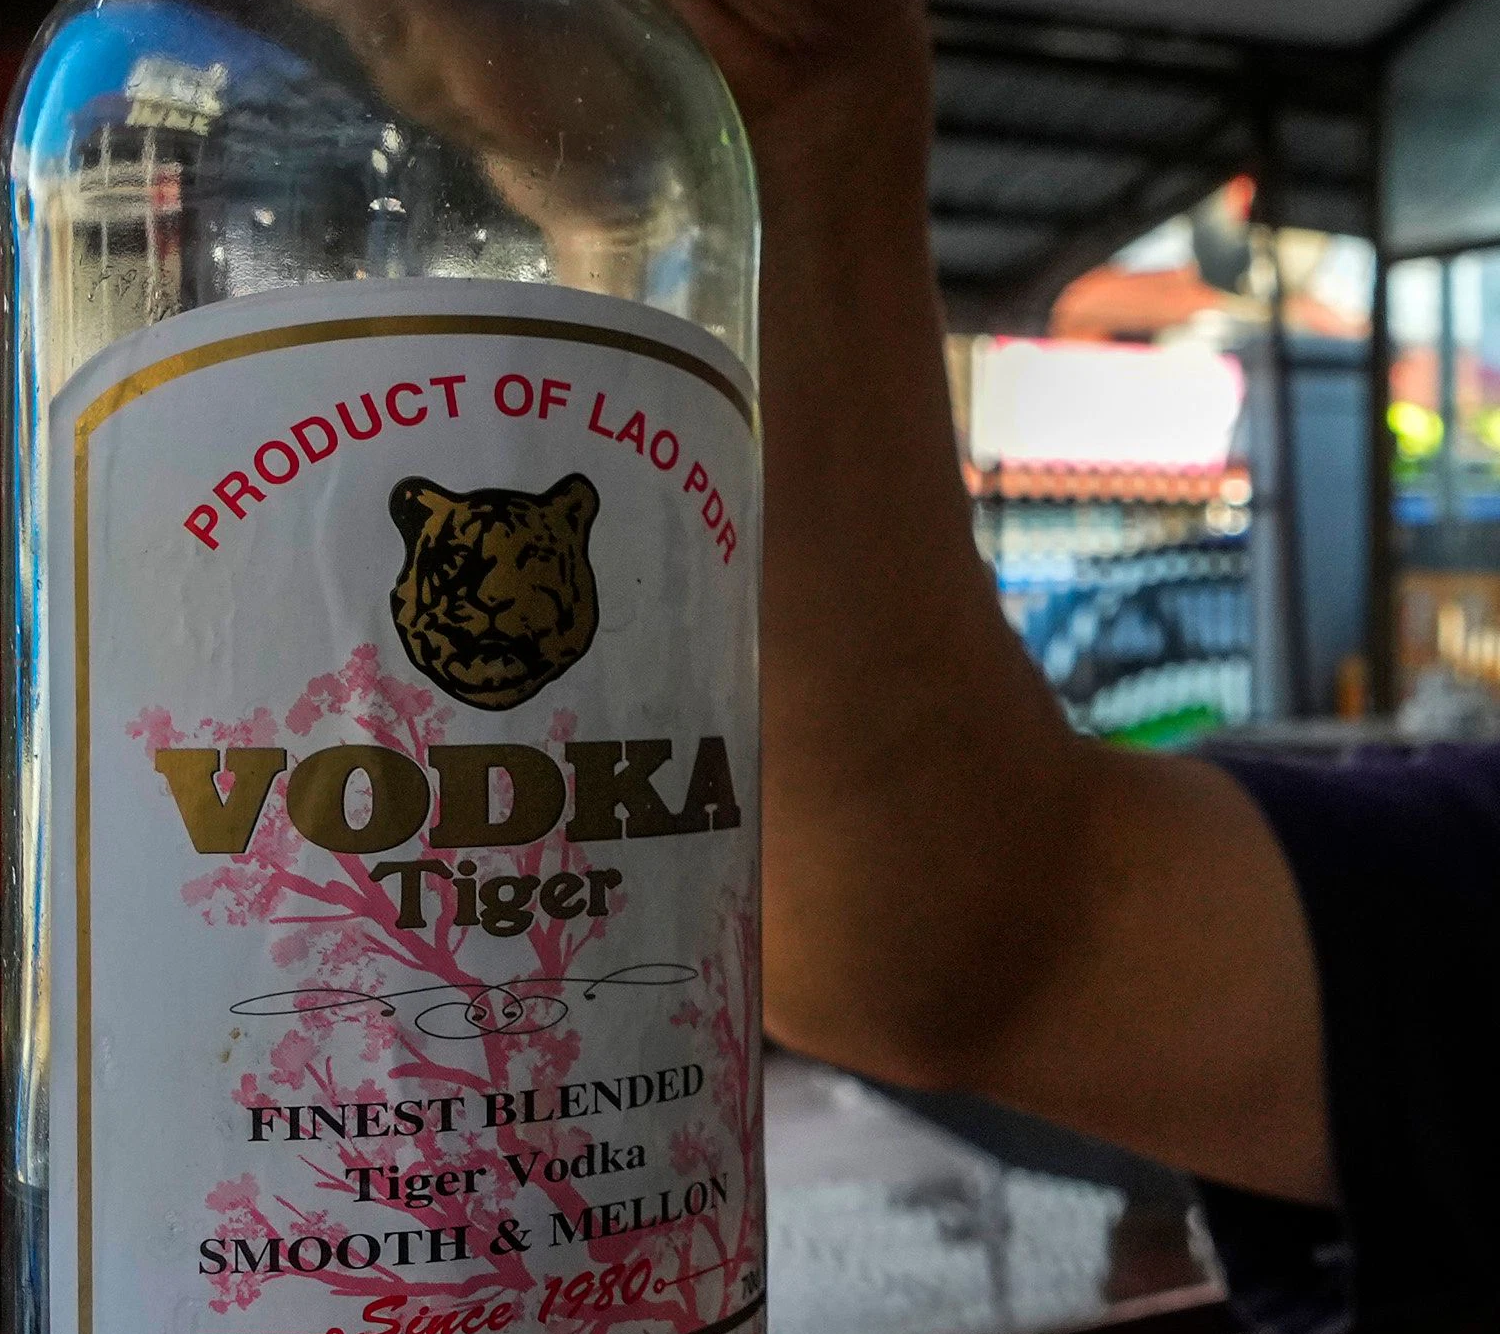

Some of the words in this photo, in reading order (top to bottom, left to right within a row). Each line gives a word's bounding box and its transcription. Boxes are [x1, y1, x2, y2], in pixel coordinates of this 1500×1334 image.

[184, 375, 467, 550] PRODUCT
[495, 373, 571, 419] OF
[588, 393, 680, 472] LAO
[683, 463, 738, 564] PDR
[156, 735, 742, 854] VODKA
[371, 858, 622, 935] Tiger
[247, 1097, 463, 1142] FINEST
[481, 1064, 703, 1130] BLENDED
[347, 1167, 486, 1209] Tiger
[505, 1140, 646, 1188] Vodka
[199, 1227, 468, 1275] SMOOTH
[488, 1218, 532, 1254] &
[551, 1175, 729, 1245] MELLON
[540, 1258, 652, 1322] 1980
